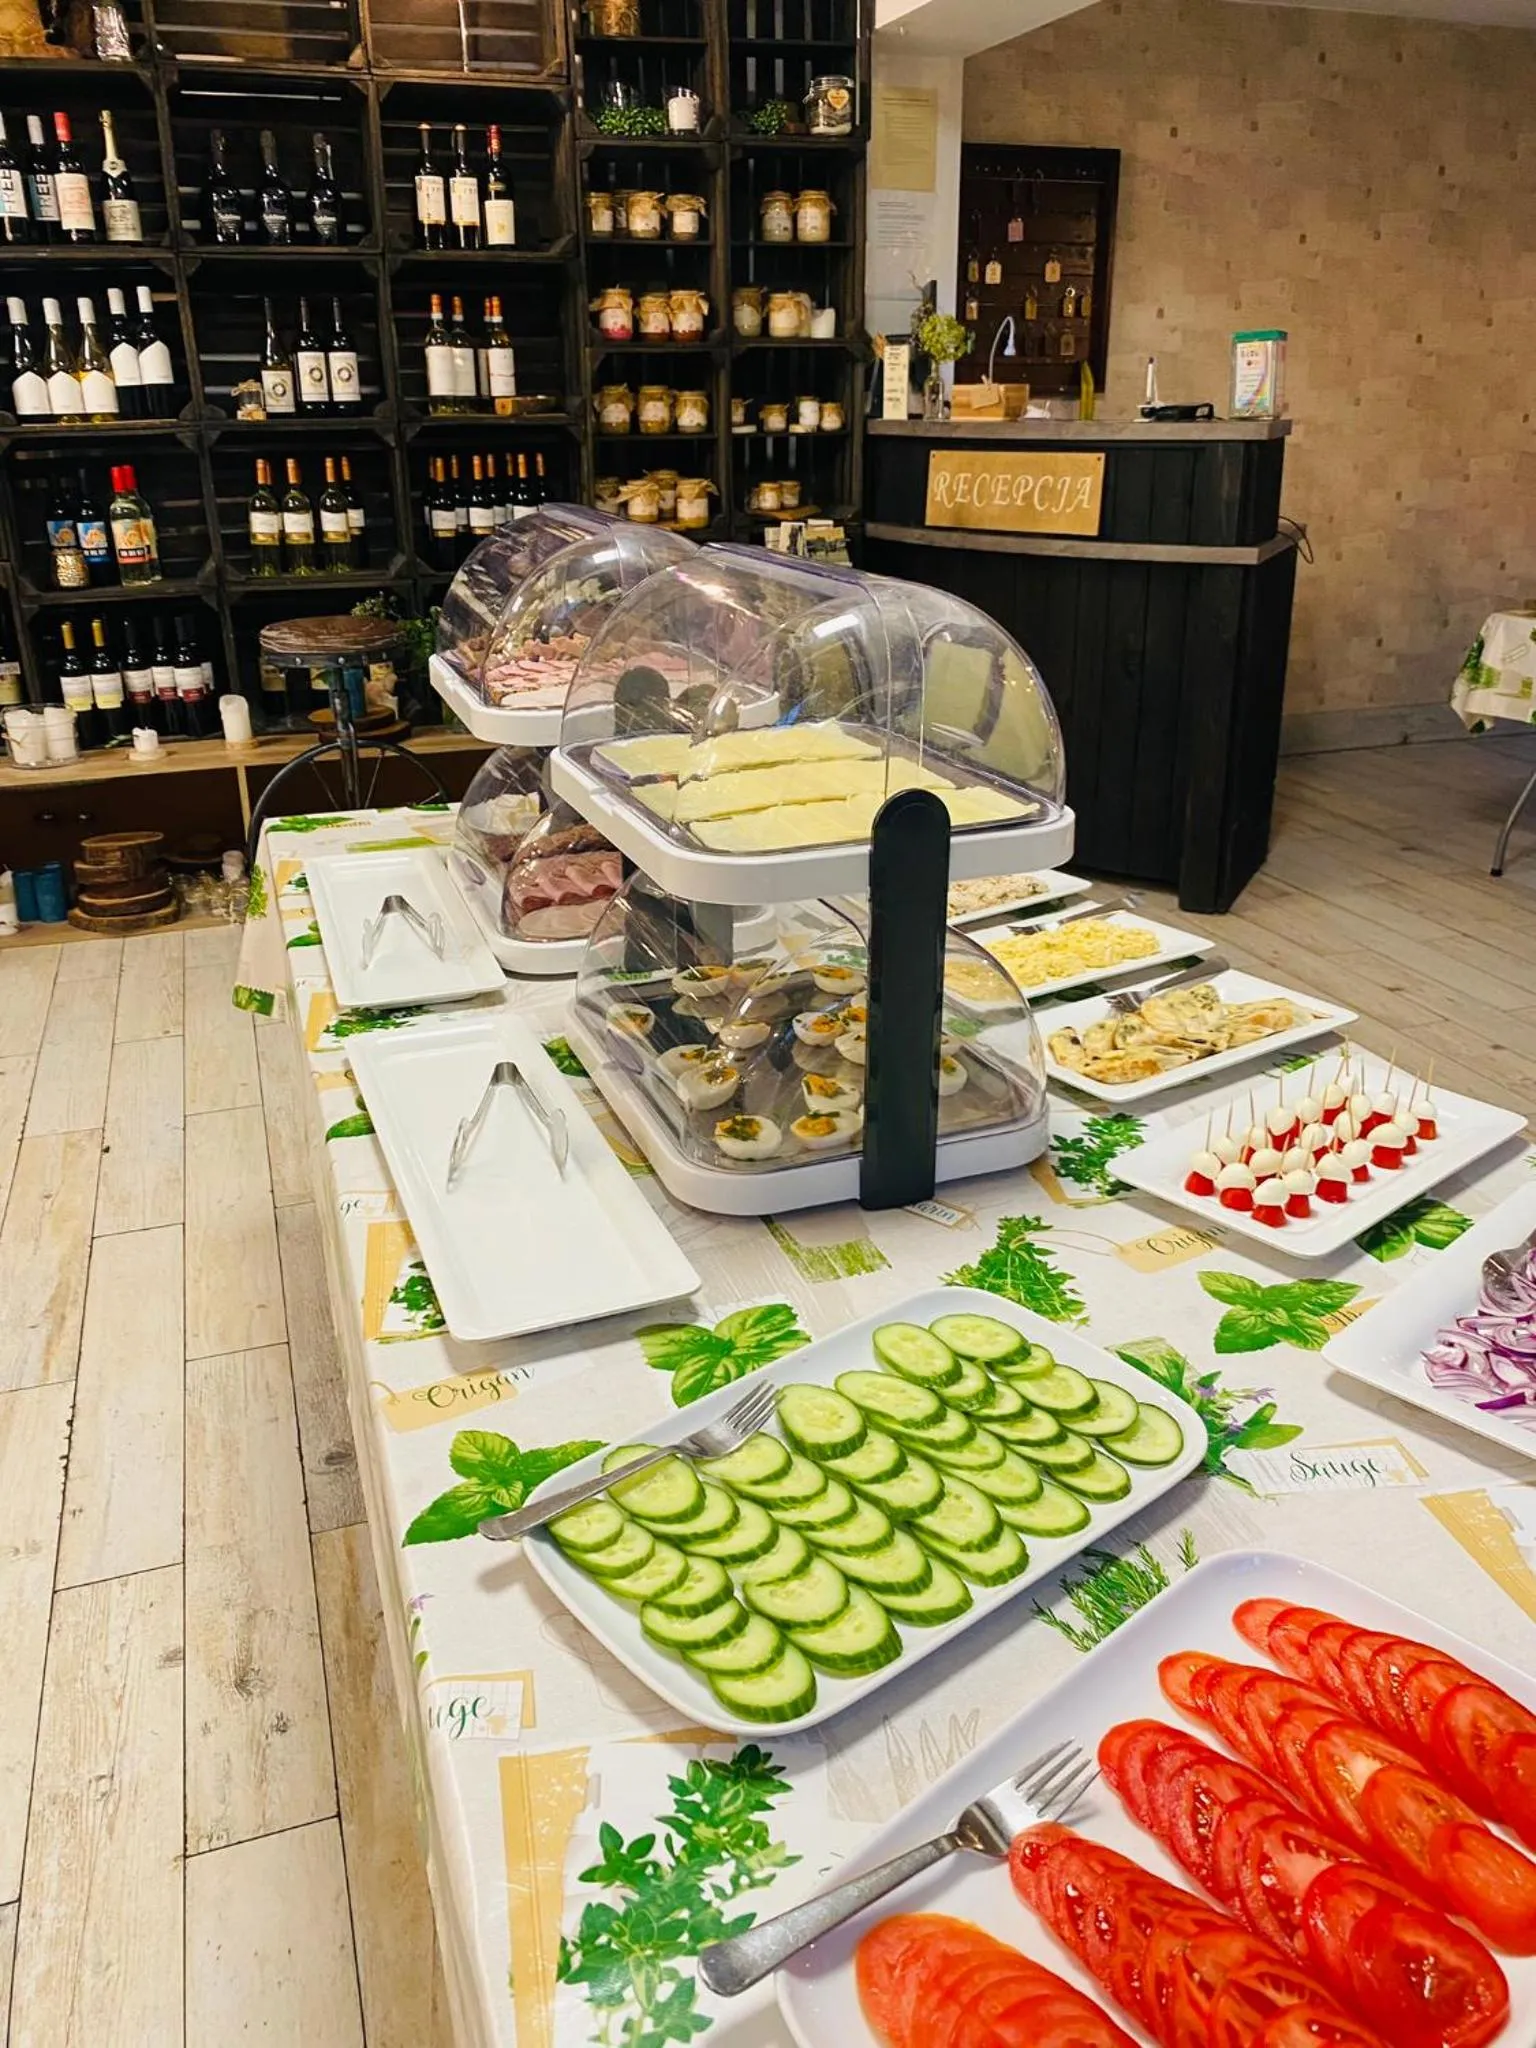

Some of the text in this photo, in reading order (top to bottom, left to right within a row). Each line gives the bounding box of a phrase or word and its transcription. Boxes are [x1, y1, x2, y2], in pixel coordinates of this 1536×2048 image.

[933, 470, 1093, 513] RECEPCJA
[412, 1367, 535, 1408] Origan
[1289, 1451, 1388, 1488] Sauge
